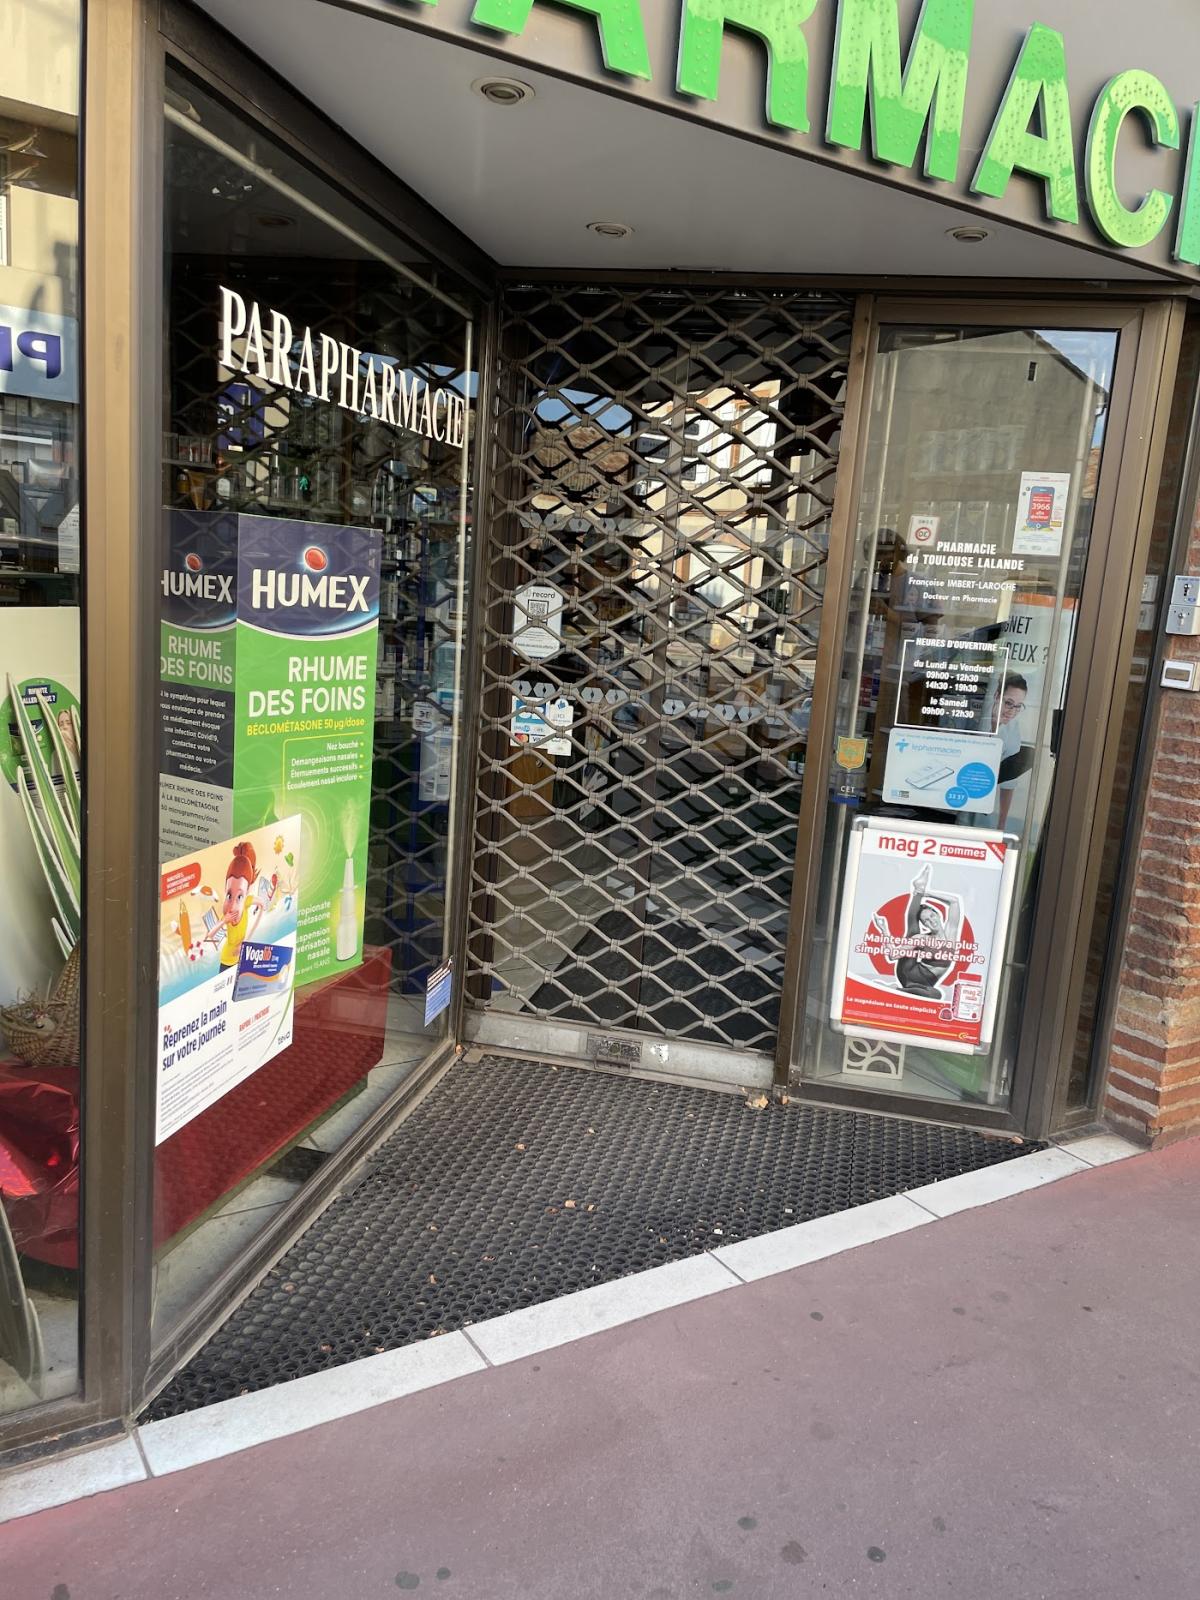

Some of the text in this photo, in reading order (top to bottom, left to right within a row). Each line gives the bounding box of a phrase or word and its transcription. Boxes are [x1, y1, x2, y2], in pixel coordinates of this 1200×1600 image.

[219, 285, 465, 449] PARAPHARMACIE
[1031, 502, 1051, 511] 3966
[936, 541, 997, 555] PHARMACIE
[906, 554, 1025, 571] de TOULOUSE LALANDE
[252, 568, 371, 613] HUMEX
[908, 577, 1017, 592] Françoise IMBERT-LAROCHE
[532, 591, 556, 599] record
[922, 592, 949, 601] Docteur
[962, 594, 998, 604] Pharmacie
[168, 635, 222, 660] RHUME
[915, 637, 998, 652] HEURES D'OUVERTURE
[160, 657, 233, 685] DES FOINS
[288, 655, 368, 683] RHUME
[913, 659, 995, 674] du Lundi au Vendredi
[925, 671, 950, 681] 09h00
[956, 673, 979, 683] 12h30
[925, 681, 949, 691] 14h30
[955, 684, 978, 693] 19h30
[248, 685, 367, 718] DES FOINS
[930, 697, 969, 708] le Samedi
[921, 706, 945, 716] 09h00
[951, 709, 975, 719] 12h30
[324, 718, 334, 729] 50
[326, 742, 338, 751] Nez
[878, 835, 920, 858] mag
[922, 838, 938, 855] 2
[940, 845, 986, 859] gommes
[298, 900, 332, 917] ropionate
[863, 932, 979, 951] Maintenant il y a plus
[854, 943, 986, 965] simple pour se détendre
[163, 1000, 228, 1051] Reprenez la main
[162, 1054, 176, 1072] sur
[176, 1038, 200, 1063] votre
[197, 1019, 227, 1052] journée
